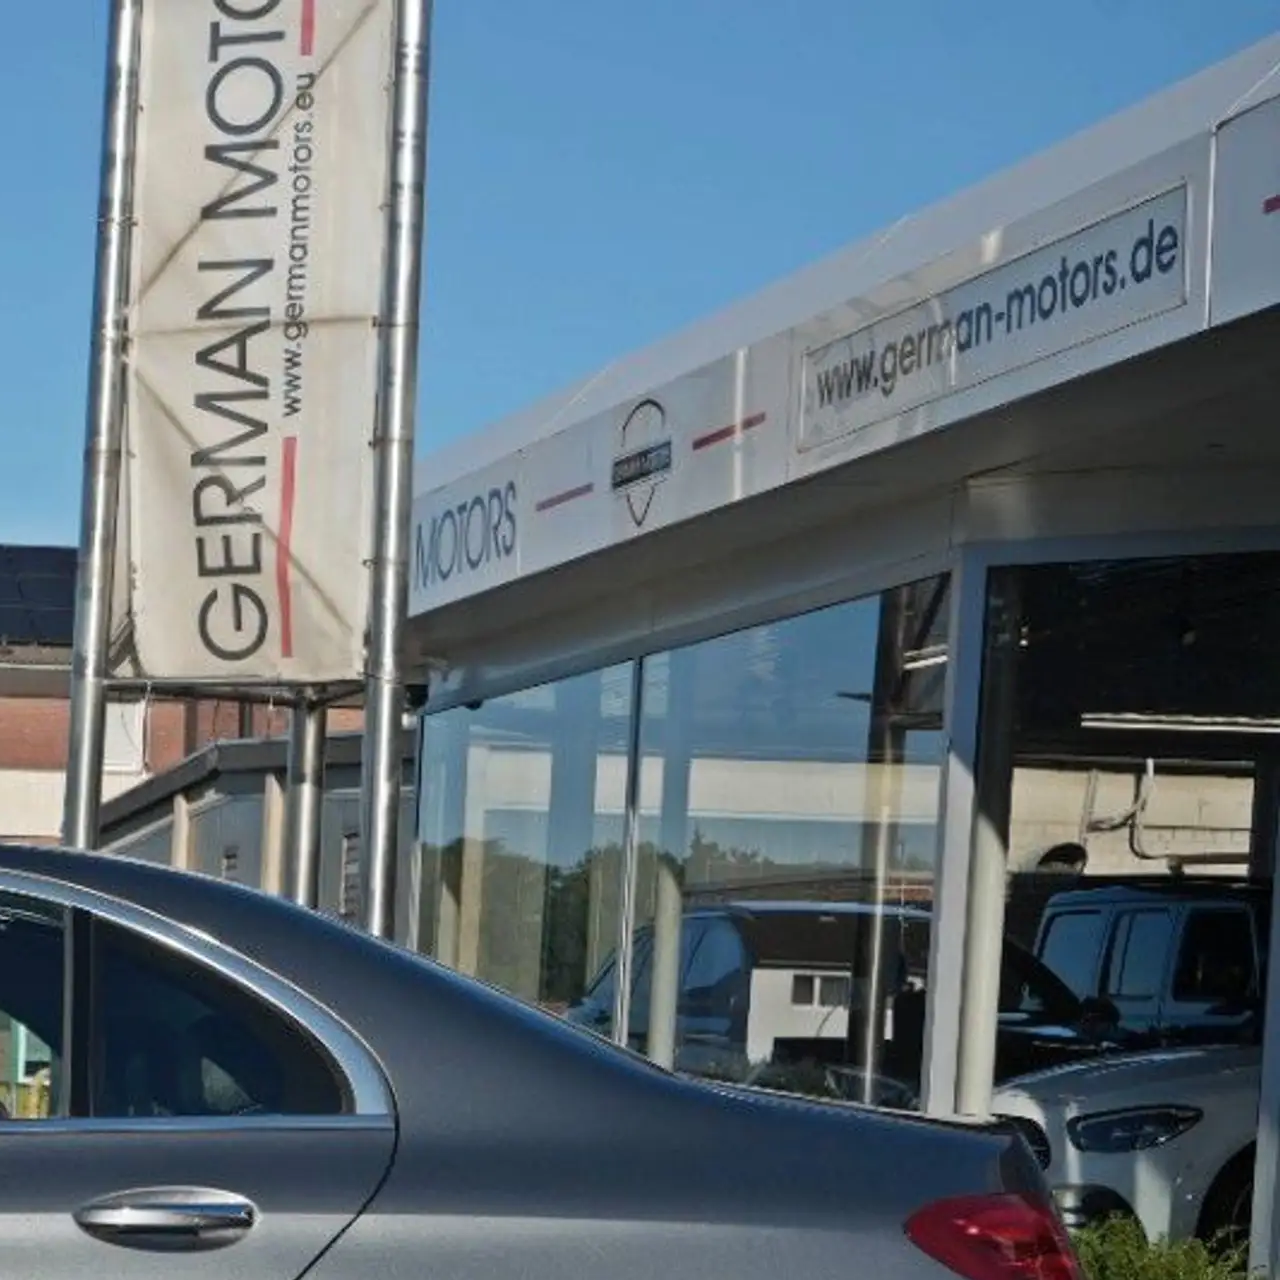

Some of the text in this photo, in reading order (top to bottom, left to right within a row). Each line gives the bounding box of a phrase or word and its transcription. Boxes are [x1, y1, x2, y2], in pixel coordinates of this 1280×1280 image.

[190, 0, 287, 661] GERMAN MOT
[282, 71, 317, 418] www.germanmotors.eu
[815, 218, 1179, 409] www.german-motors.de
[413, 479, 517, 593] MOTORS
